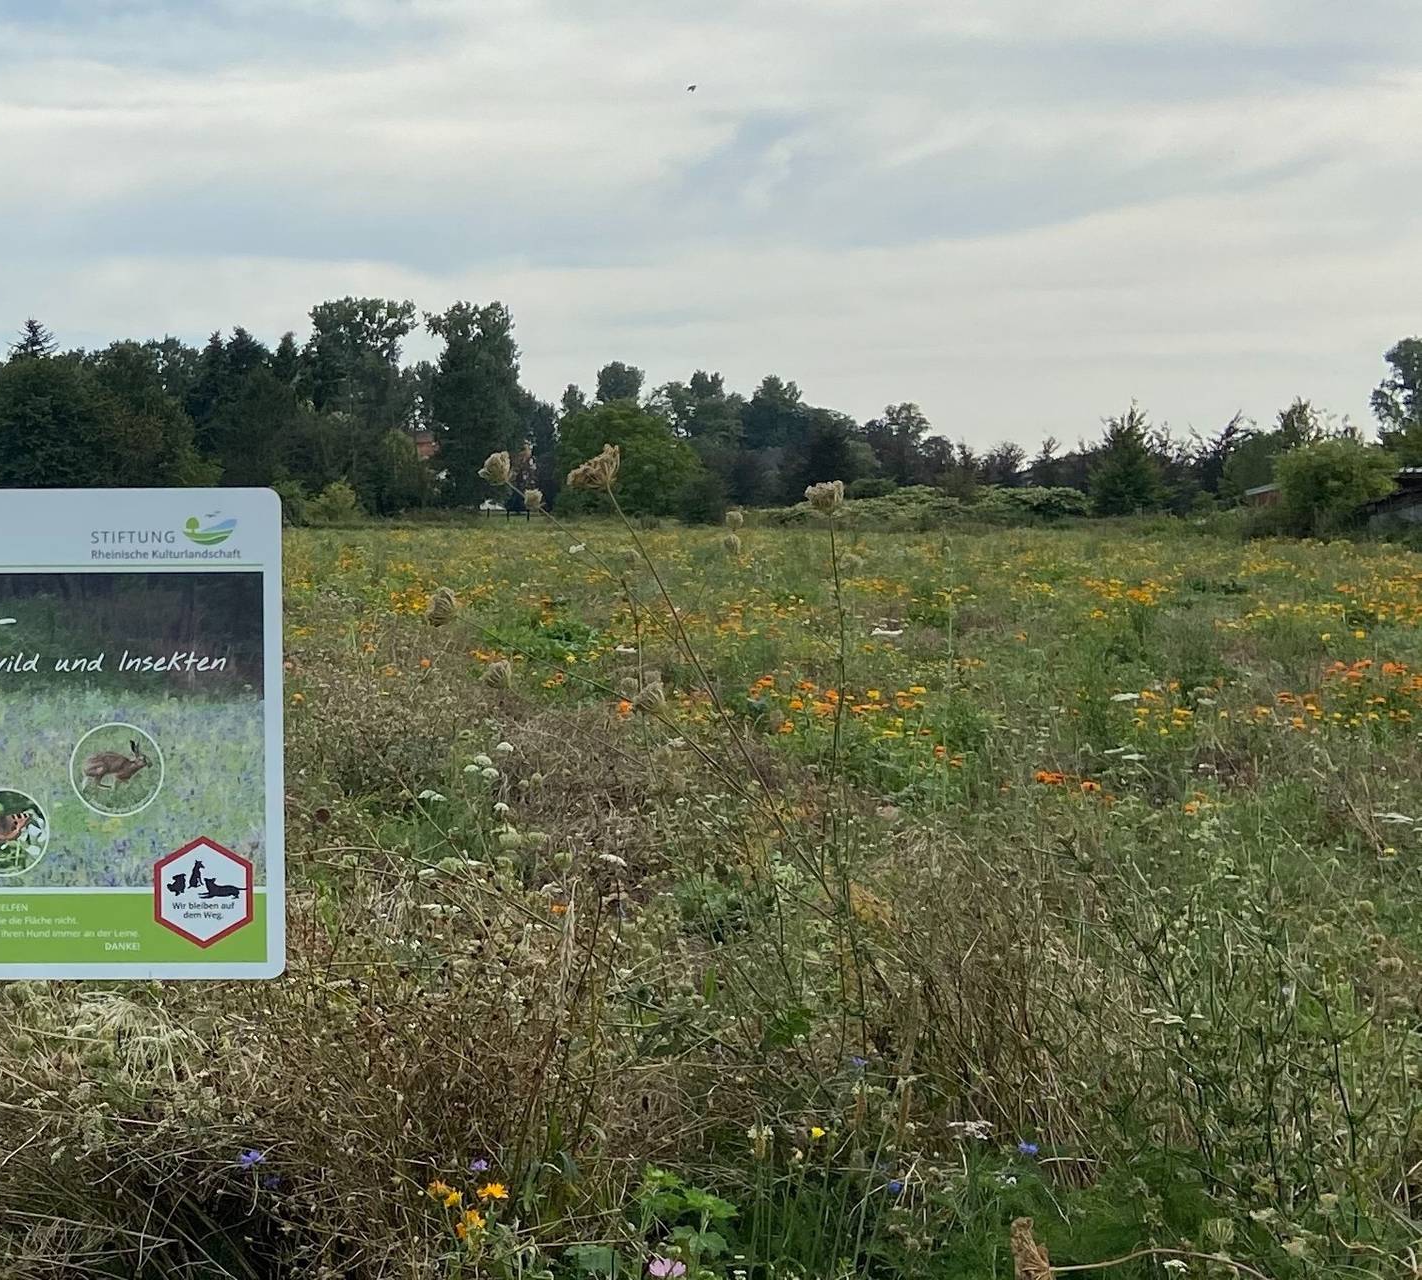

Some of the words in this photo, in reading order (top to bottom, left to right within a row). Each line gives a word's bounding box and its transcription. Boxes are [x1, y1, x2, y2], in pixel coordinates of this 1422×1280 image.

[90, 531, 175, 544] STIFTUNG
[91, 550, 149, 559] Rheinische
[152, 549, 241, 559] Kulturlandschaft
[54, 653, 104, 672] und
[119, 651, 226, 672] Insekten
[172, 902, 186, 910] Wir
[189, 902, 219, 910] bleiben
[221, 902, 235, 910] auf
[204, 912, 224, 920] Weg.
[8, 917, 22, 925] die
[25, 916, 51, 925] Fläche
[27, 930, 51, 938] Hund
[52, 930, 81, 938] immer
[97, 930, 112, 938] der
[104, 943, 141, 951] DANKE!
